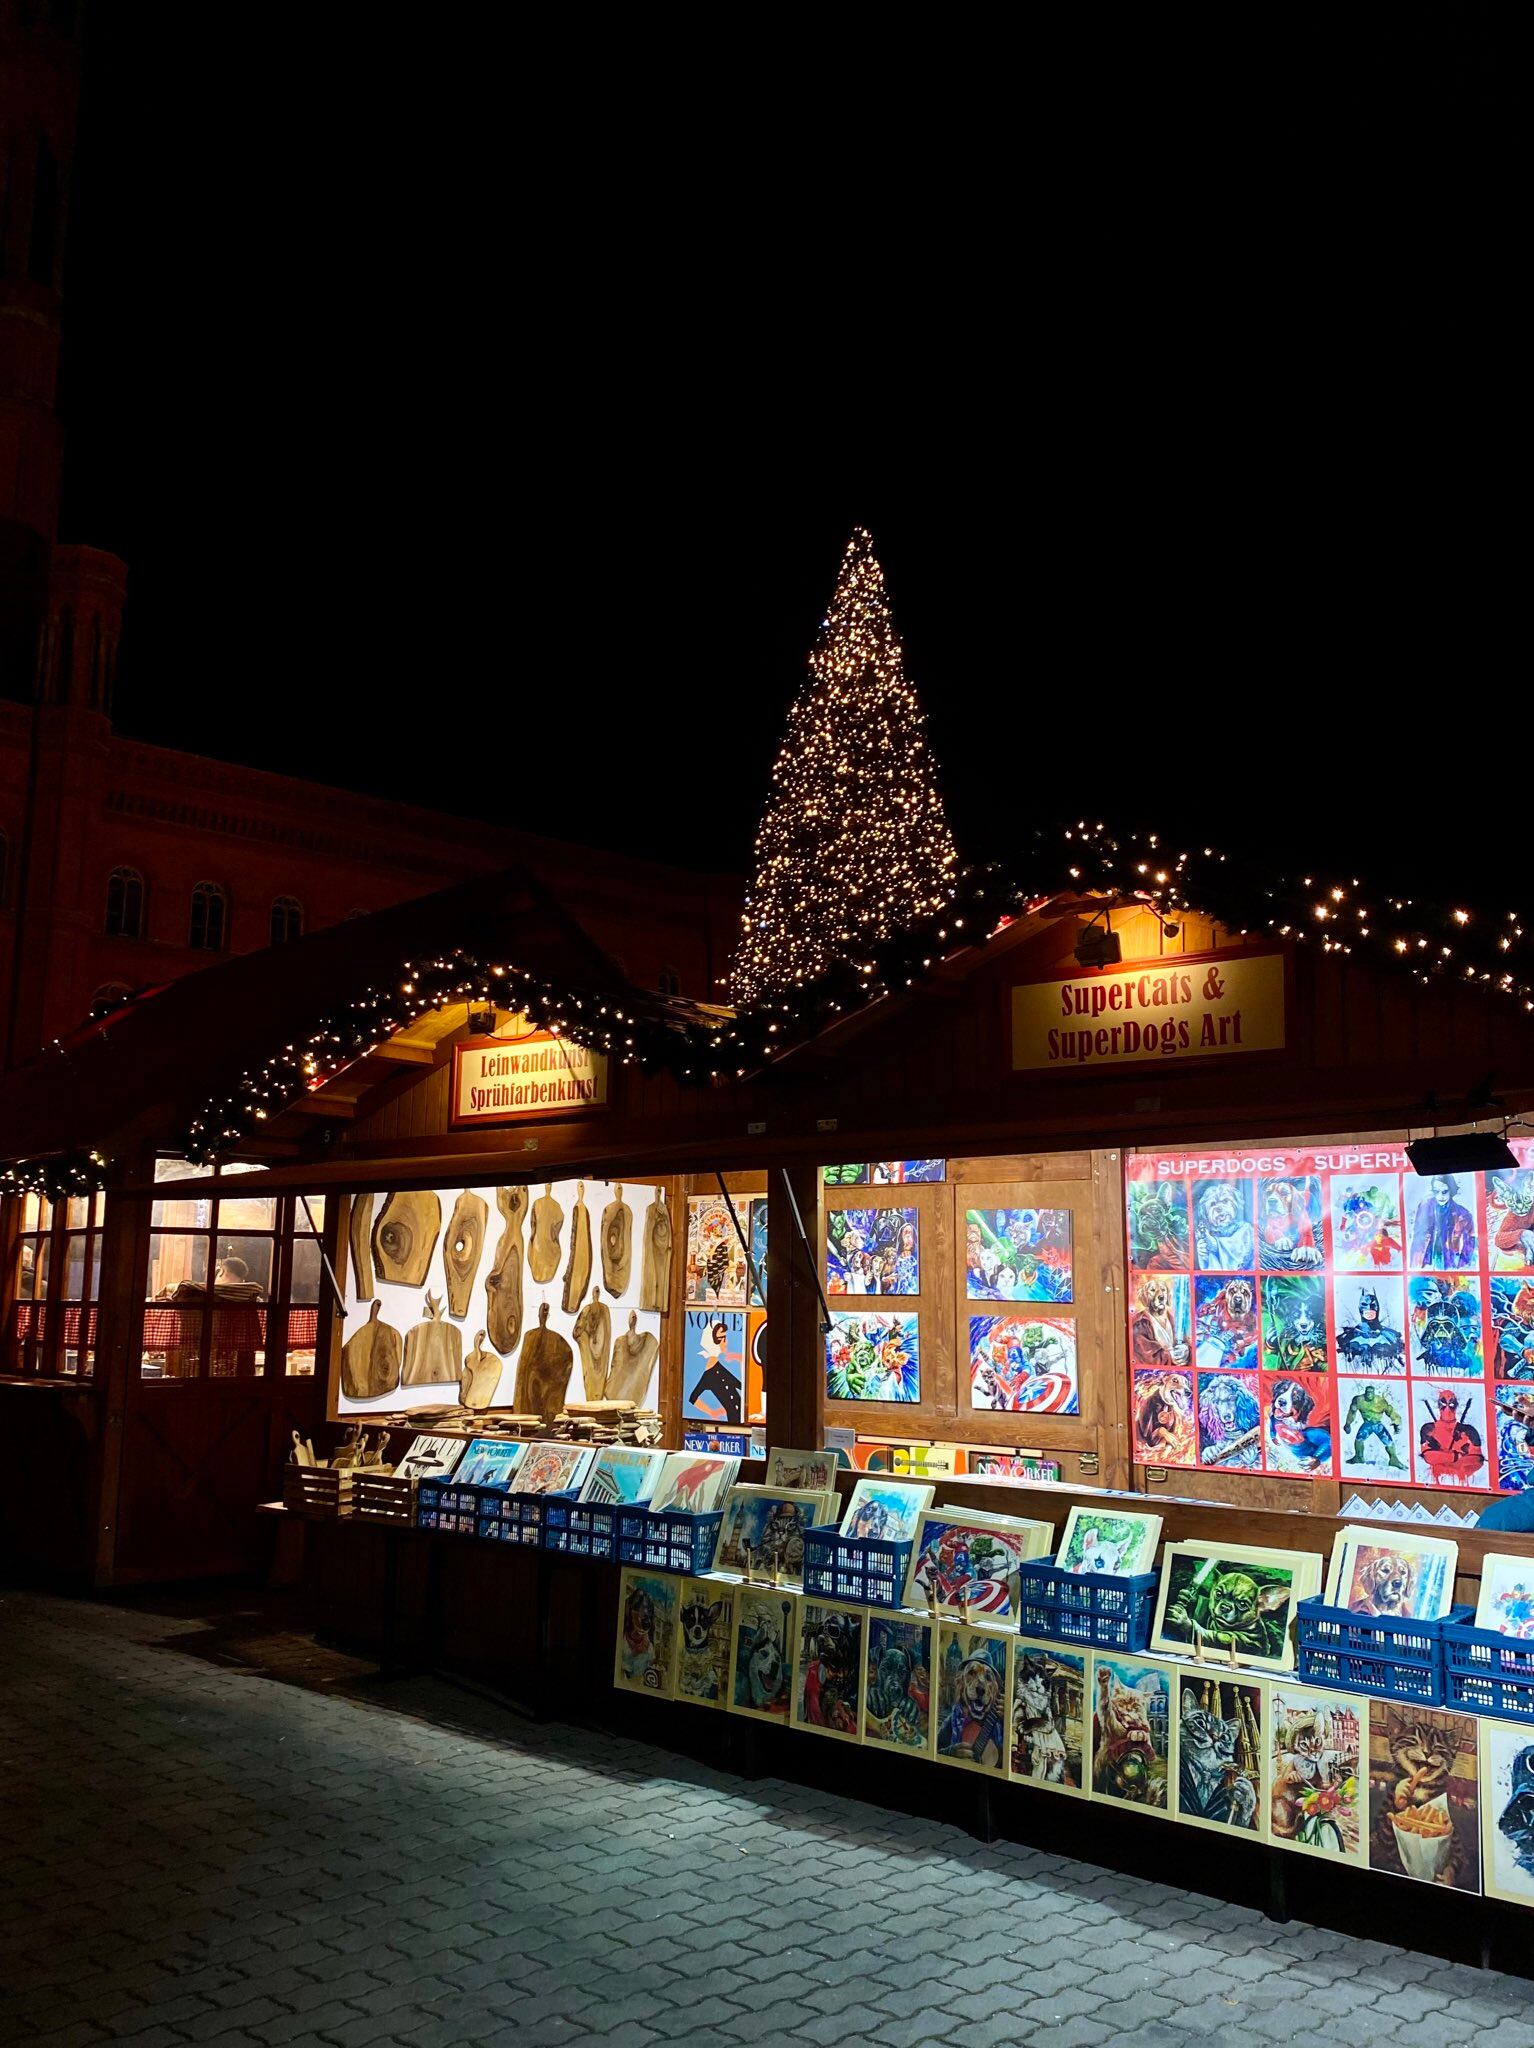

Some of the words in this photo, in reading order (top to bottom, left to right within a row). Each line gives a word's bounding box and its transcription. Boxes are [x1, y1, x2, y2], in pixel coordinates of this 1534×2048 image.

[1061, 972, 1192, 1017] SuperCats
[1202, 966, 1226, 1001] &
[1047, 1016, 1190, 1062] SuperDogs
[1199, 1009, 1243, 1047] Art
[481, 1049, 589, 1078] Leinwandkunst
[471, 1075, 598, 1111] Sprühfarbenkunst
[1157, 1156, 1286, 1175] SUPERDOGS
[1313, 1151, 1414, 1171] SUPERH
[688, 1311, 743, 1331] VOGUE
[413, 1436, 459, 1457] VOGUE
[684, 1439, 705, 1451] NEW
[705, 1440, 741, 1454] YRKER
[751, 1445, 767, 1456] NE
[978, 1462, 1004, 1477] NEW
[1008, 1465, 1053, 1481] YORKER
